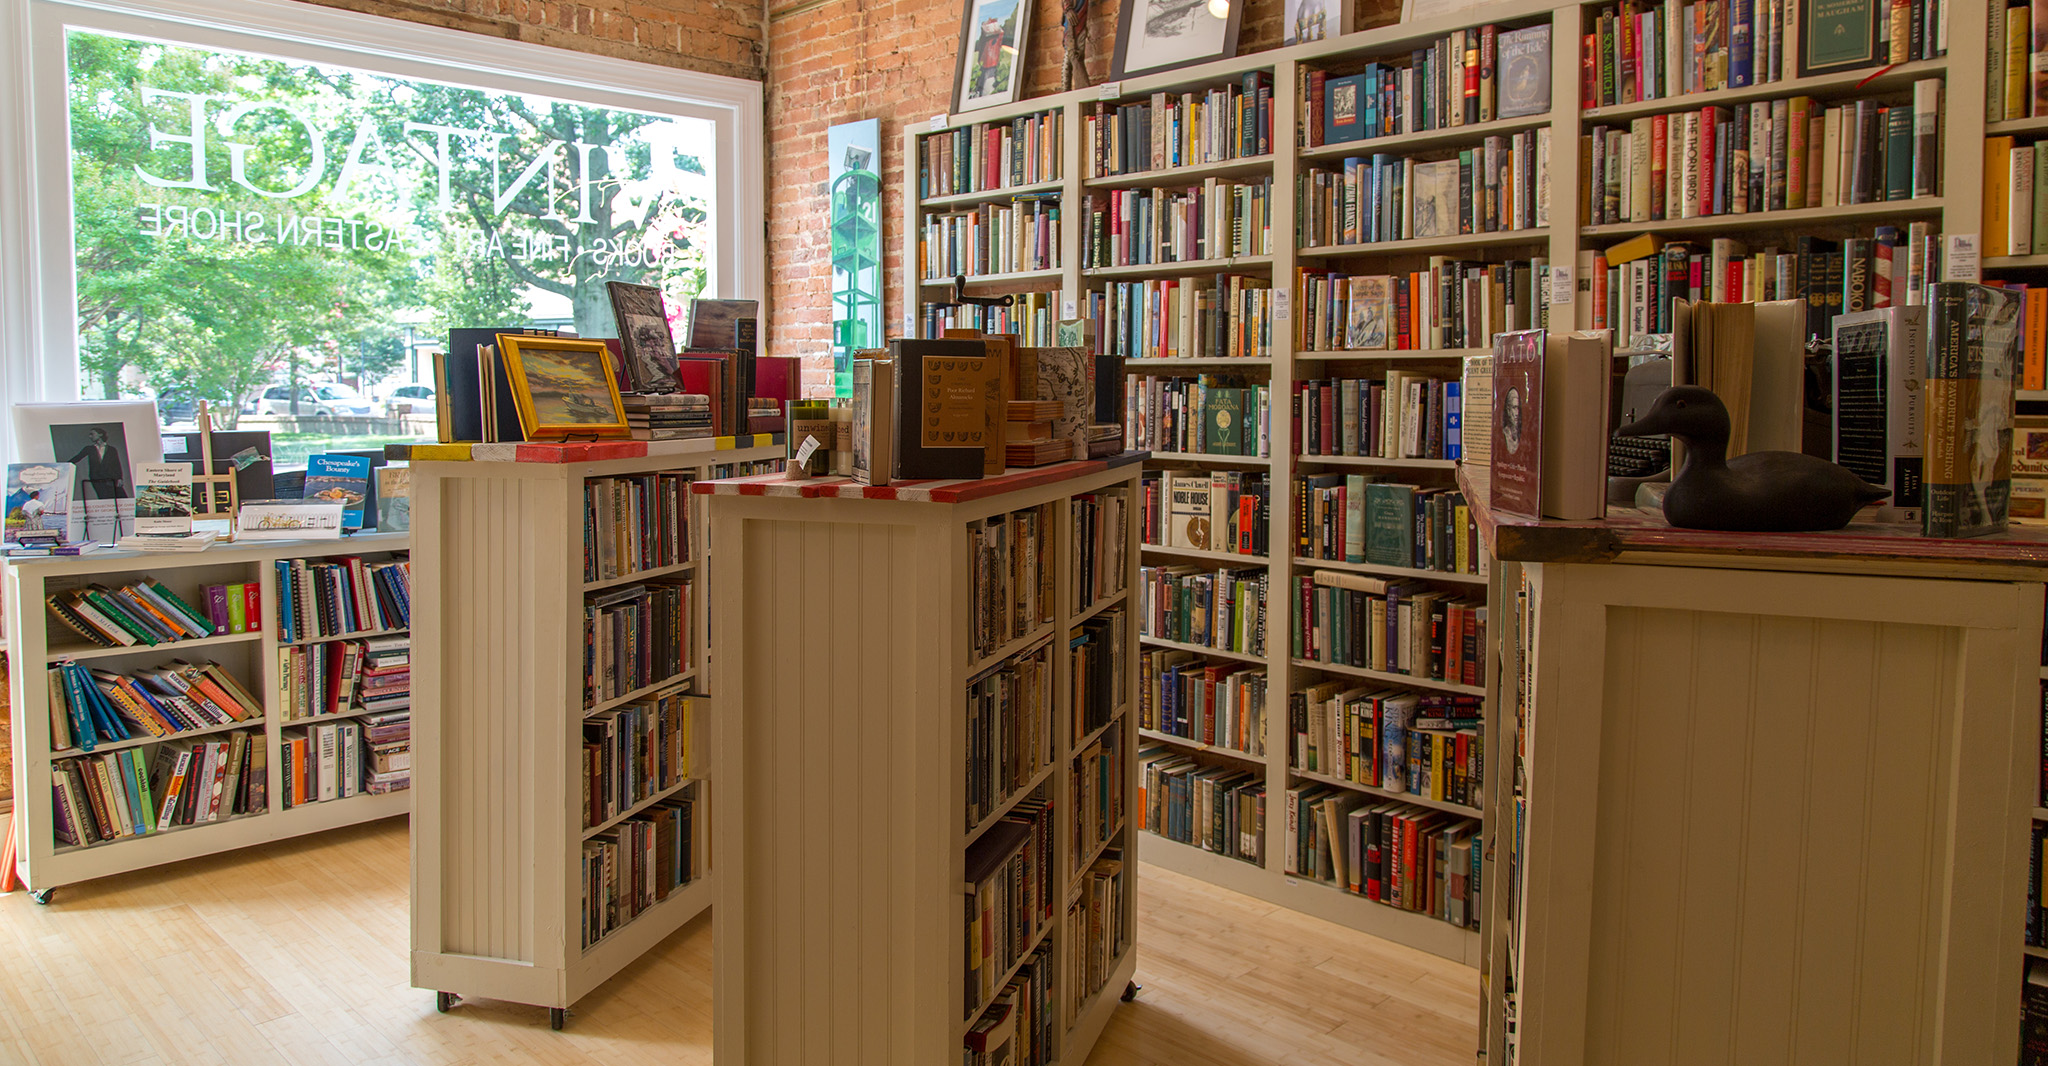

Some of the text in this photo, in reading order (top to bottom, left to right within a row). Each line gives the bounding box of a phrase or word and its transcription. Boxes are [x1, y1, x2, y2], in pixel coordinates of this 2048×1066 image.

[1817, 5, 1865, 18] MAUGHAM
[1500, 26, 1550, 45] The Running
[1453, 45, 1461, 70] TRIPLE
[1502, 42, 1544, 58] of the Tide
[1603, 33, 1612, 95] SON WITCH
[1793, 111, 1805, 150] Texasville
[1639, 133, 1647, 165] COLLEEN
[1687, 117, 1698, 202] THE THORN BIRDS
[2022, 150, 2031, 177] MARRY
[1345, 204, 1355, 230] FRANZEN
[1650, 257, 1658, 282] LEGACY
[1667, 262, 1688, 270] ALASKA
[1454, 302, 1460, 314] US
[1634, 267, 1645, 332] JAMES MICHENER Chesapeake
[1399, 293, 1407, 332] JOHN GRISHAM
[1496, 343, 1536, 365] PLATO
[1908, 328, 1917, 436] INGENIOUS PURSUITS
[1944, 320, 1960, 479] AMERICA'S FAVORITE FISHING
[317, 458, 360, 468] Chesapeake's
[325, 466, 350, 474] Bounty
[1174, 480, 1208, 488] James Clavell
[1904, 469, 1912, 496] JARDINE
[1930, 488, 1956, 496] Outdoor
[1174, 491, 1208, 505] NOBLE HOUSE
[1932, 510, 1954, 518] Harper
[628, 630, 636, 676] VIRGINIA
[128, 688, 146, 706] Chowders
[204, 701, 224, 720] Grilling
[1384, 706, 1392, 738] KING
[1468, 756, 1476, 778] KOONTZ
[137, 768, 147, 792] cocktail
[163, 798, 175, 821] Grilling
[1288, 793, 1296, 832] Jerzy Kosinski
